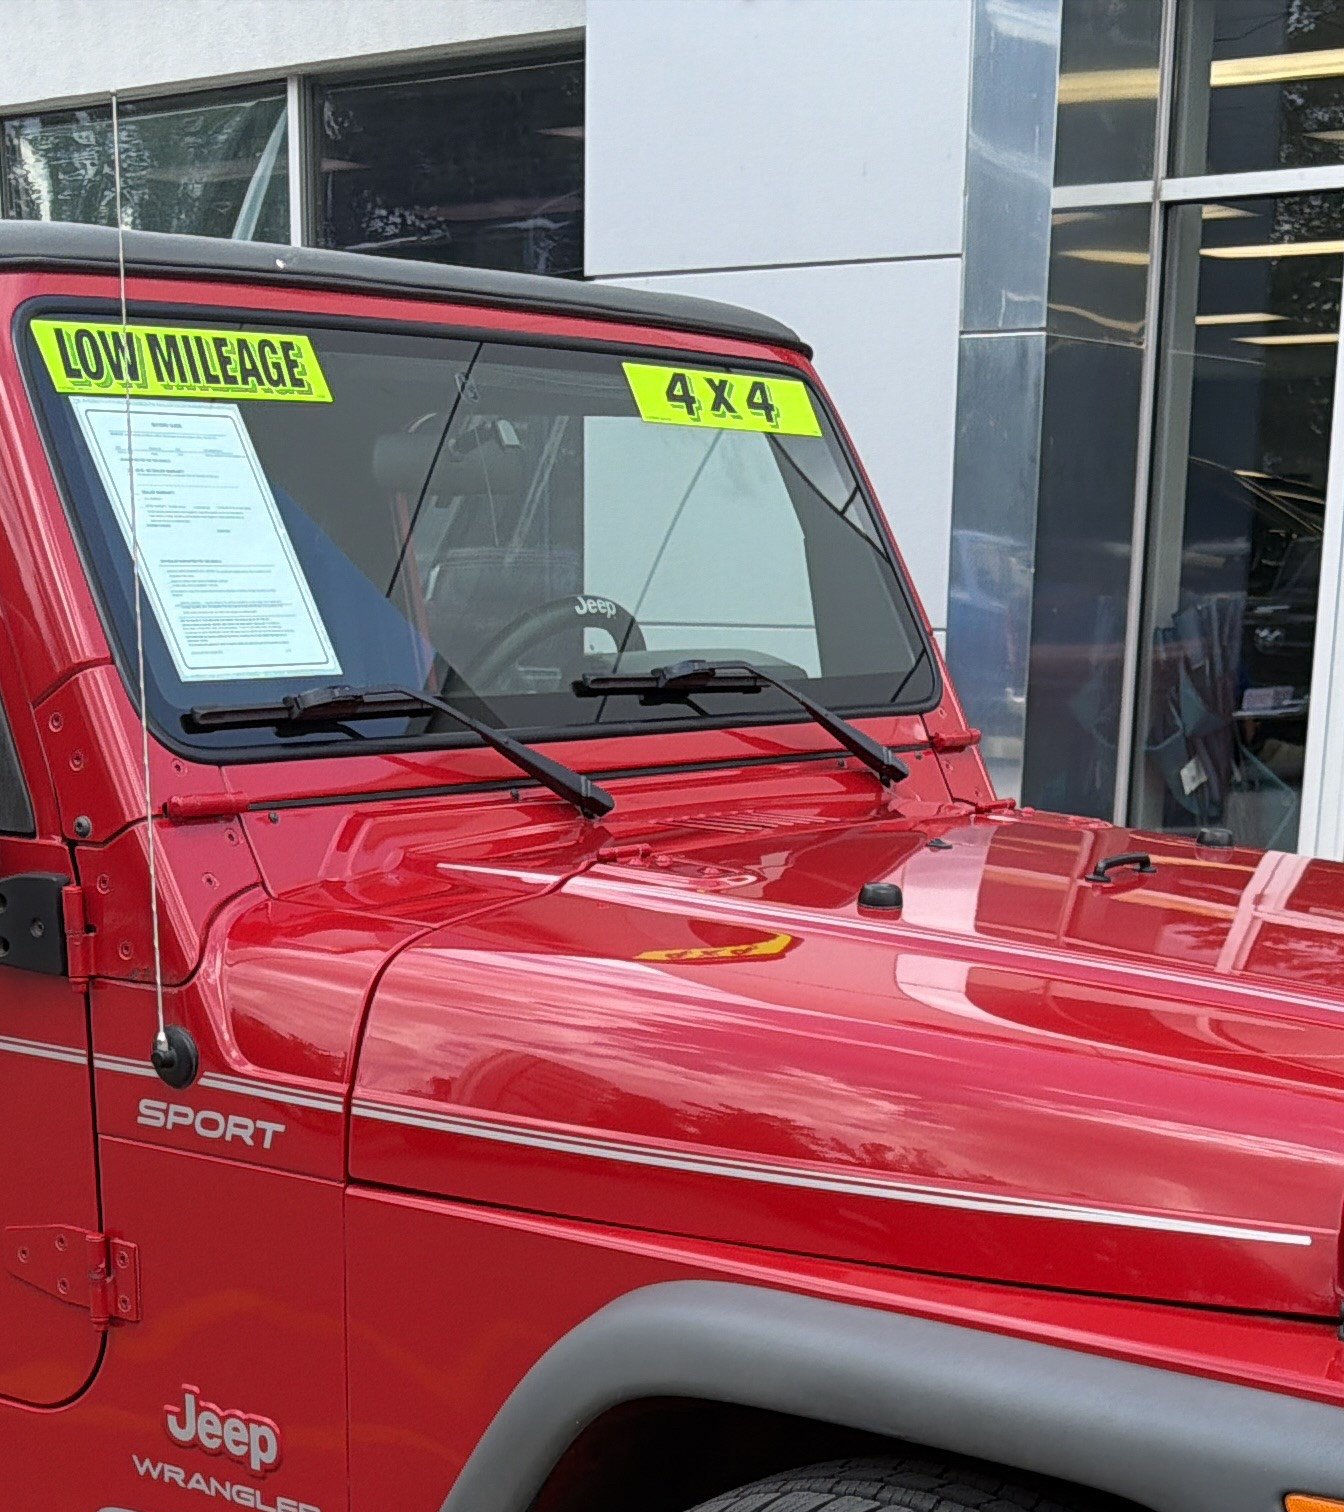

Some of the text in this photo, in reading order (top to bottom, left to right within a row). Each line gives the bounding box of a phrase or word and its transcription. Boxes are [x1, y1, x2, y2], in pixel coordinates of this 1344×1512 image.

[53, 327, 311, 391] LOW MILEAGE
[575, 596, 617, 619] Jeep
[136, 1098, 286, 1150] SPORT
[164, 1385, 281, 1472] Jeep
